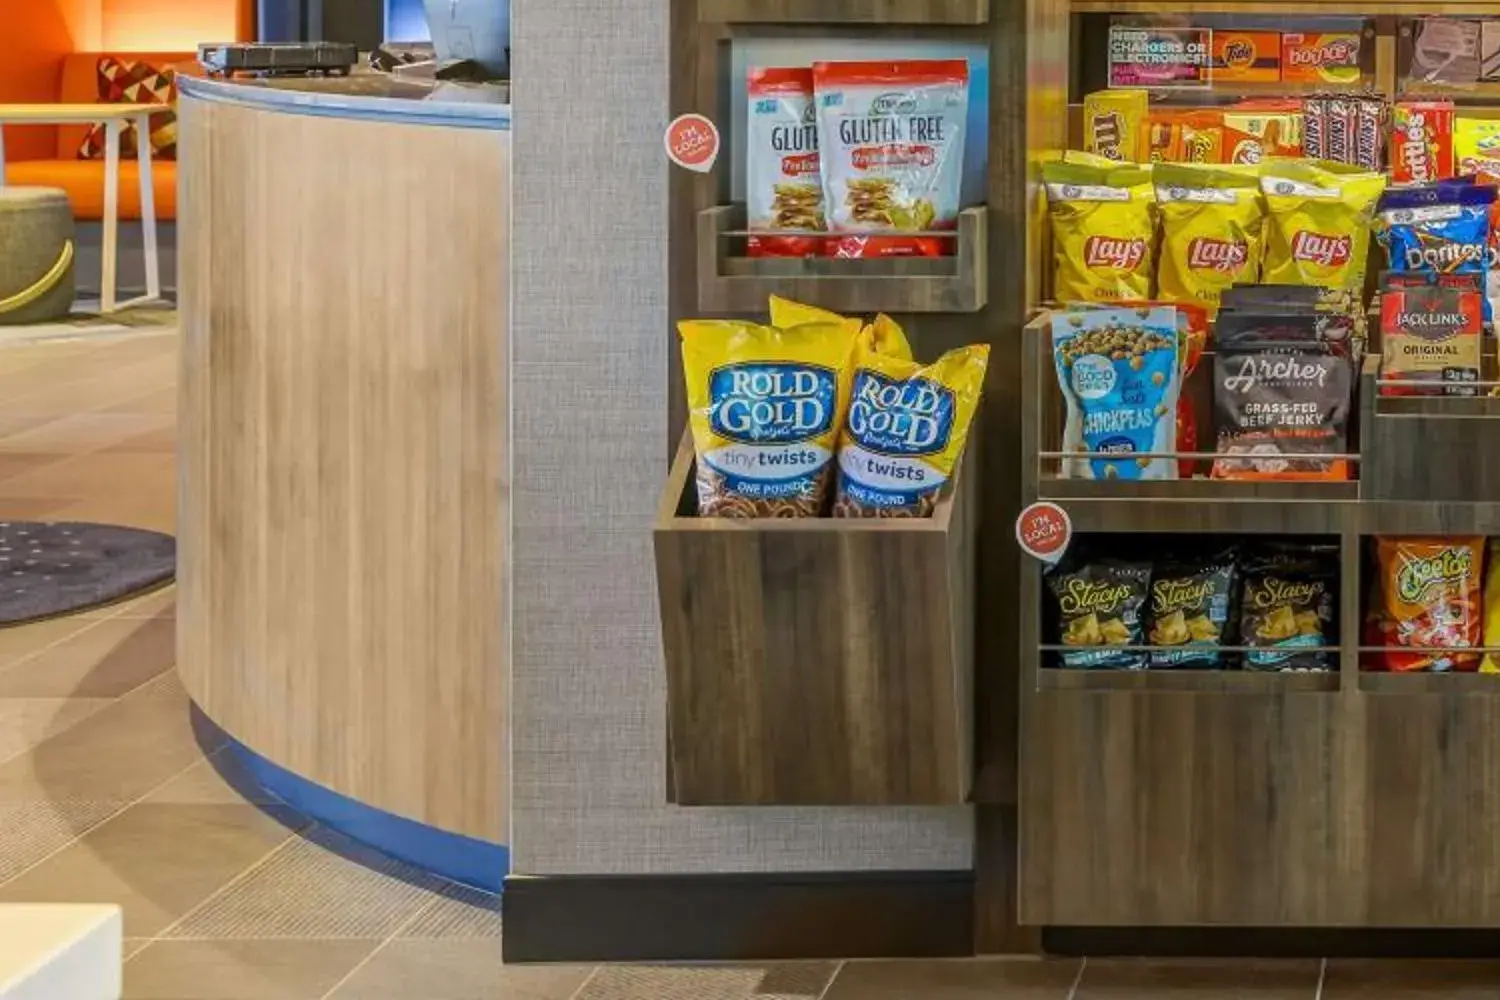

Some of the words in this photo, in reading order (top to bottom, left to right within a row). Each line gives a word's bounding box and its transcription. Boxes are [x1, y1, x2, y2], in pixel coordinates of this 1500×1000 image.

[1111, 41, 1184, 53] CHARGERS
[1186, 42, 1207, 53] OR
[771, 125, 819, 151] GLUTE
[839, 116, 903, 145] GLUTEN
[908, 115, 945, 142] FREE
[1359, 115, 1377, 166] SNICKE
[1404, 112, 1429, 187] kittles
[1087, 237, 1147, 269] Lay's
[1190, 237, 1248, 270] Lay's
[1295, 231, 1351, 265] Lay's
[1407, 242, 1484, 269] Doritos
[730, 370, 819, 400] ROLD
[1223, 355, 1328, 394] Archer
[859, 375, 940, 415] ROLD
[1244, 402, 1318, 415] GRASS-FED
[719, 397, 824, 433] GOLD
[848, 399, 940, 448] GOLD
[1278, 413, 1324, 426] JERKY
[758, 448, 817, 465] twists
[866, 459, 925, 481] twists
[737, 481, 761, 494] ONE
[1060, 578, 1134, 614] Stacy's
[1152, 578, 1216, 612] Stacy's
[1255, 577, 1325, 608] Stacy's
